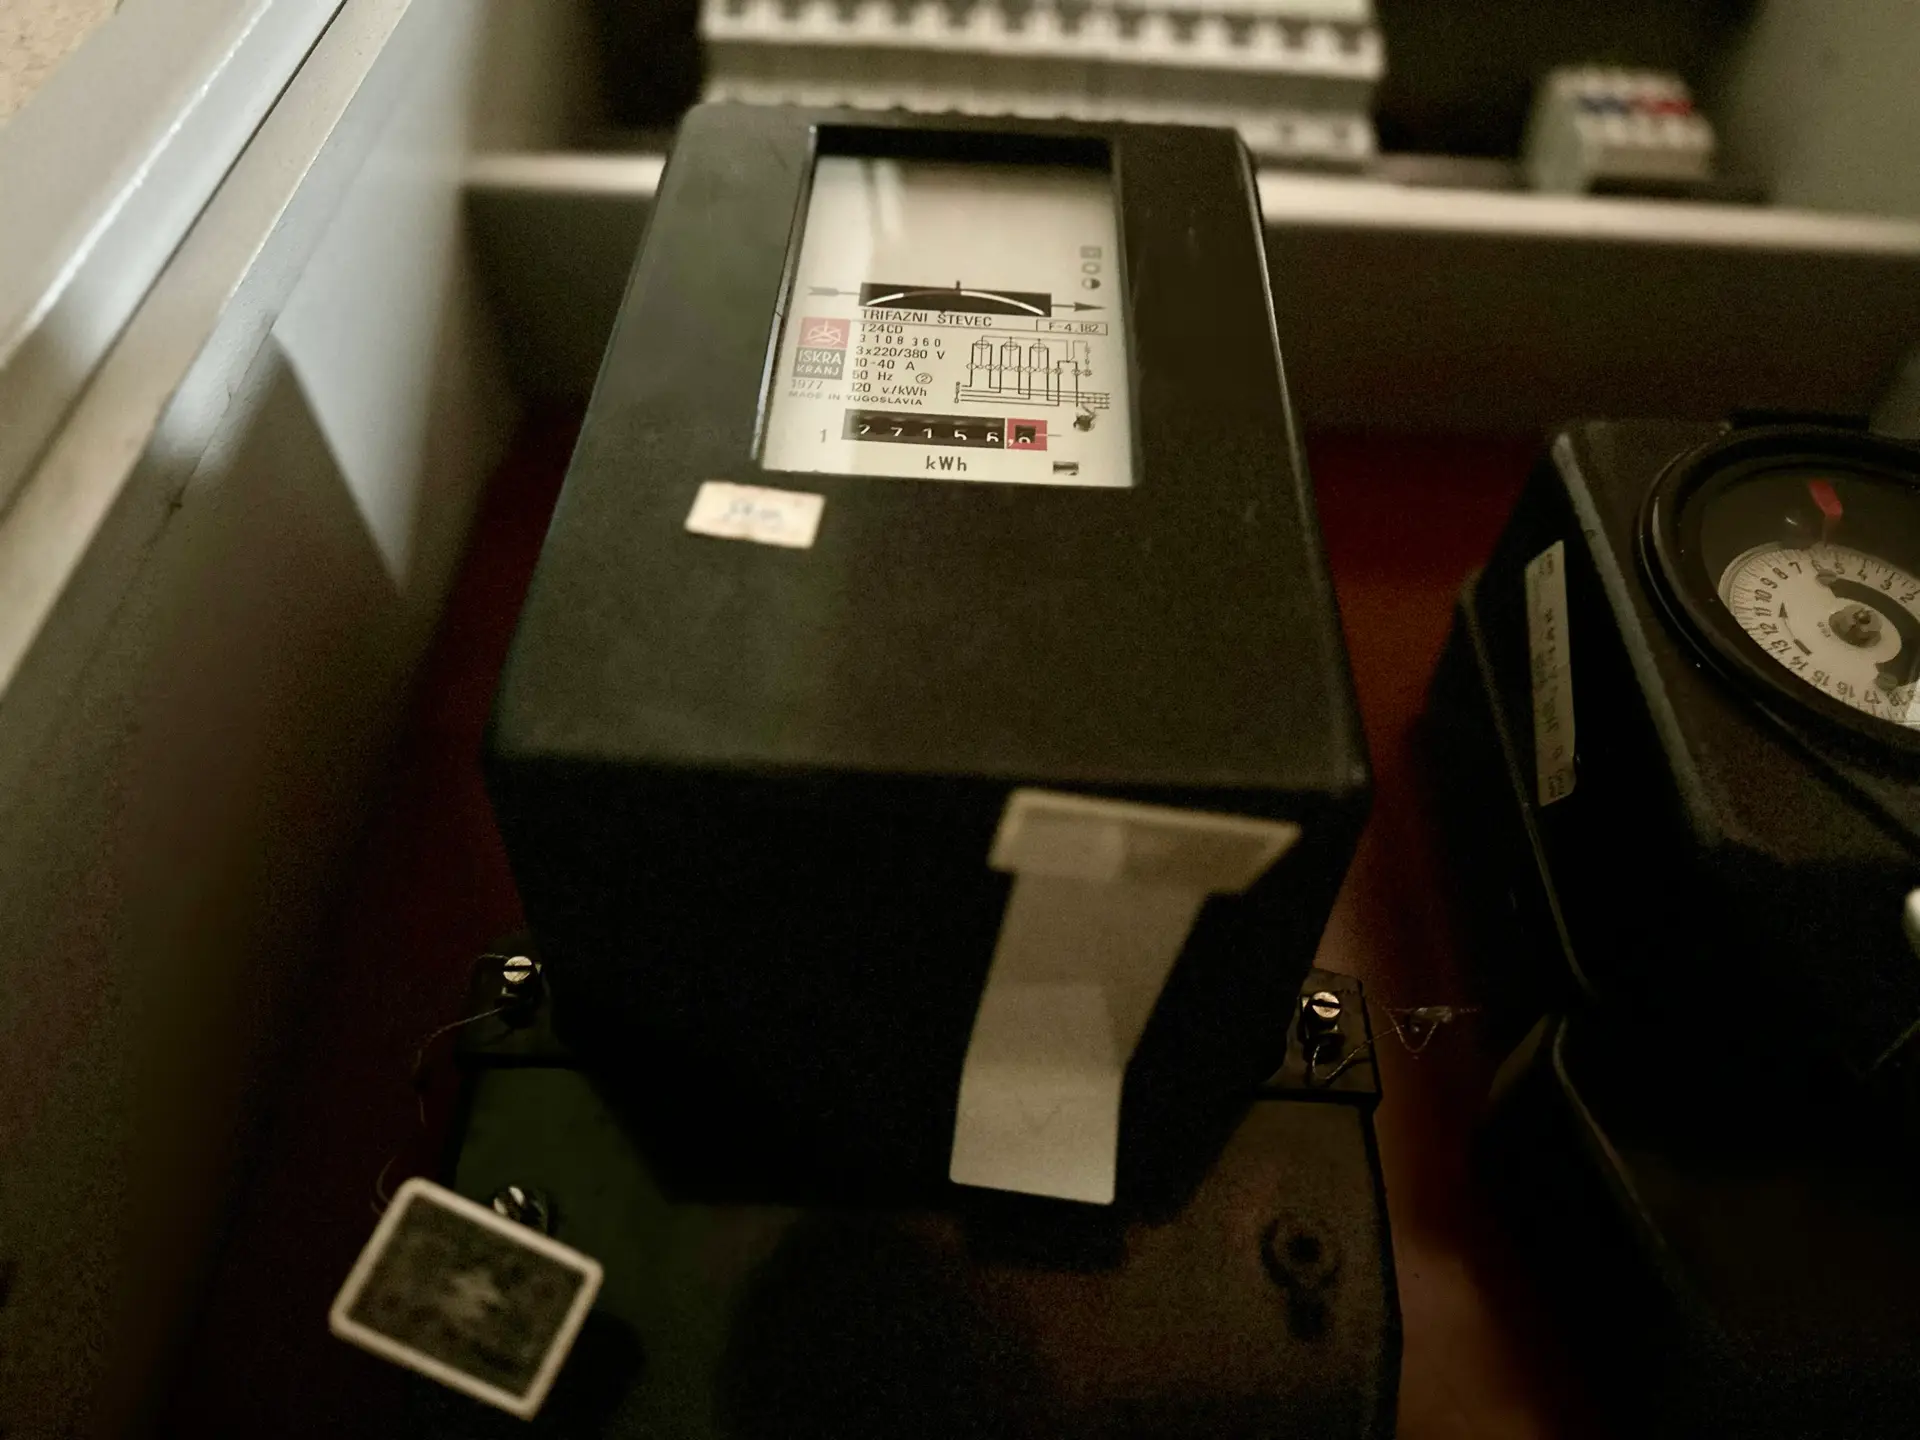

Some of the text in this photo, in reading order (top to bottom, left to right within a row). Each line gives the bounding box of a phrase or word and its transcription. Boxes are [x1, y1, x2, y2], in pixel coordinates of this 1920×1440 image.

[861, 308, 993, 327] TRIFAZNI ŠTEVEC
[861, 323, 904, 334] T24CD
[797, 350, 843, 365] ISKRA
[856, 346, 946, 360] 3x220/380 V
[795, 364, 841, 376] KRANJ
[854, 358, 916, 371] 10-40 A
[852, 370, 893, 382] 50 Hz
[791, 379, 824, 391] 1977
[851, 382, 871, 393] 120
[788, 390, 923, 406] MADE IN YUGOSLAVIA
[925, 454, 969, 472] kWh
[1772, 567, 1789, 581] 8
[1788, 562, 1803, 575] 7
[1760, 577, 1778, 589] 9
[1880, 579, 1893, 591] 3
[1754, 588, 1774, 603] 10
[1900, 593, 1915, 604] 2
[1754, 605, 1773, 618] 11
[1760, 622, 1779, 636] 12
[1771, 640, 1792, 655] 13
[1790, 656, 1810, 671] 14
[1811, 670, 1832, 686] 15
[1836, 681, 1856, 698] 16
[1863, 690, 1882, 704] 17
